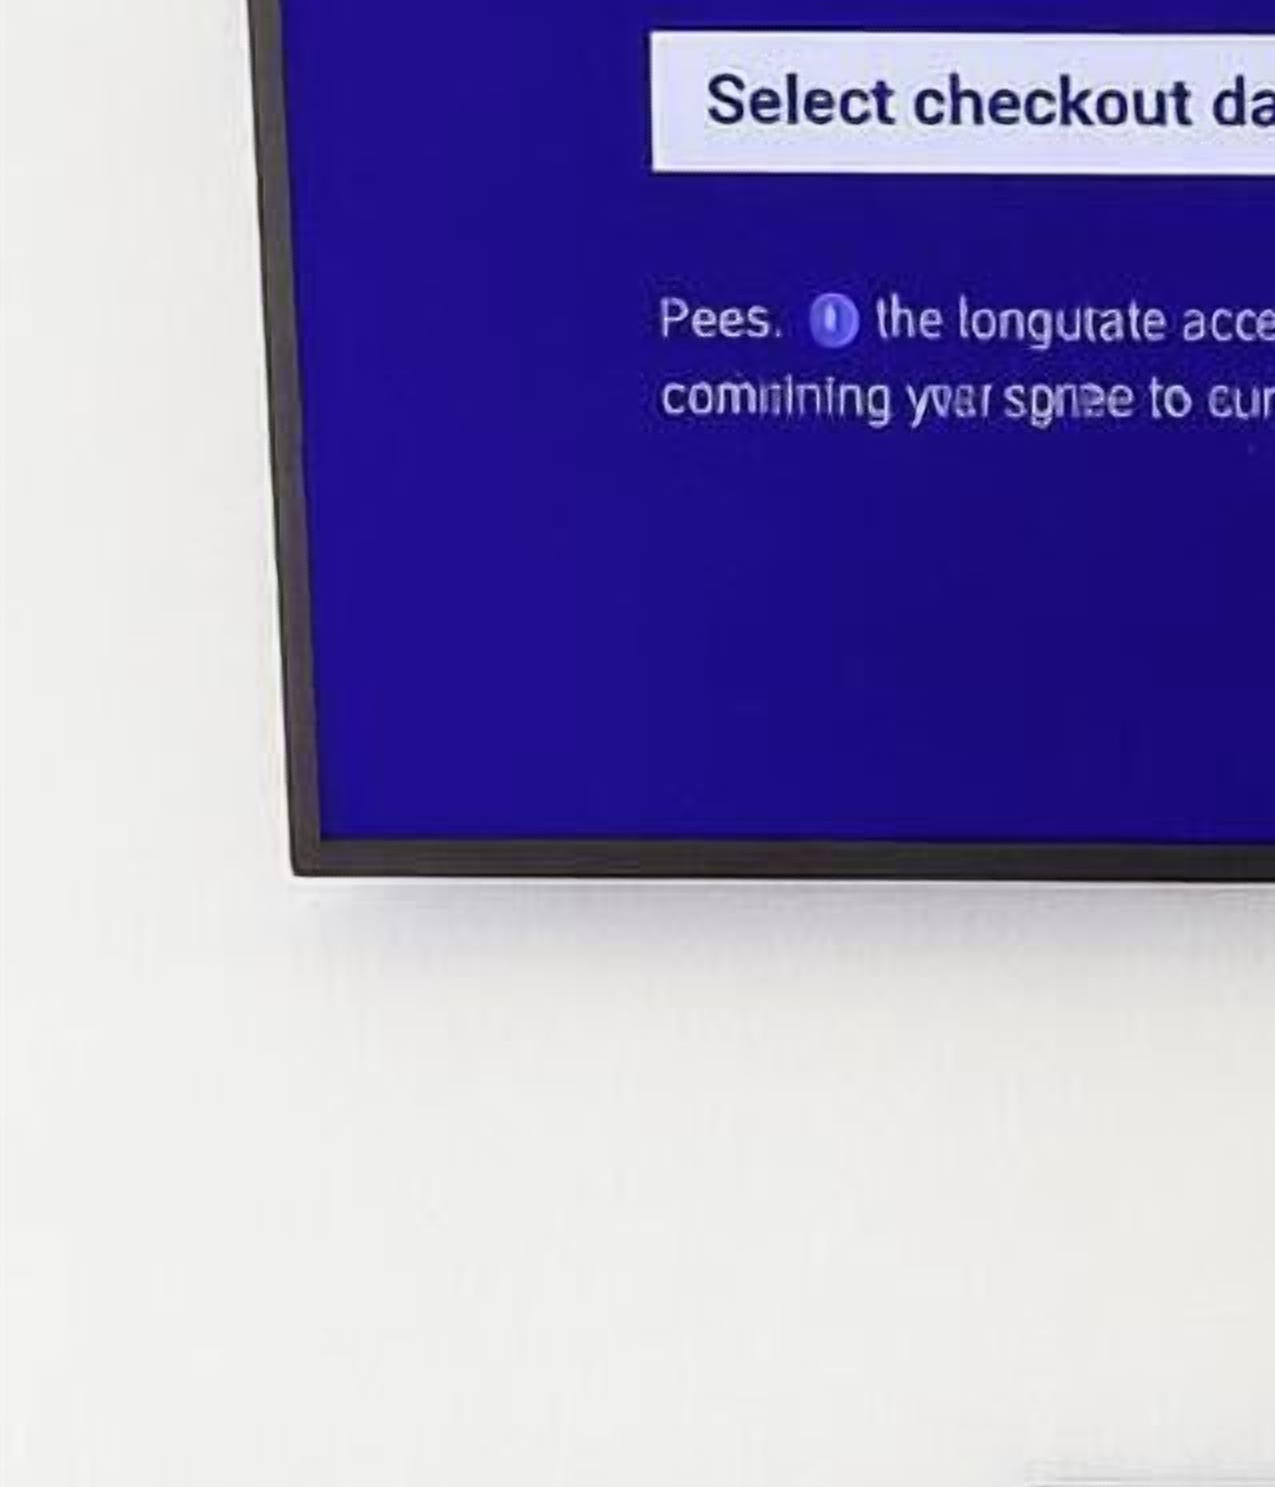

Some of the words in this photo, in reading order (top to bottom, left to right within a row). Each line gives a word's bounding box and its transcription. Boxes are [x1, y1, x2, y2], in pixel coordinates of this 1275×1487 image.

[708, 72, 896, 126] Select
[914, 72, 1193, 126] checkout
[876, 292, 943, 339] the
[1148, 376, 1193, 419] to
